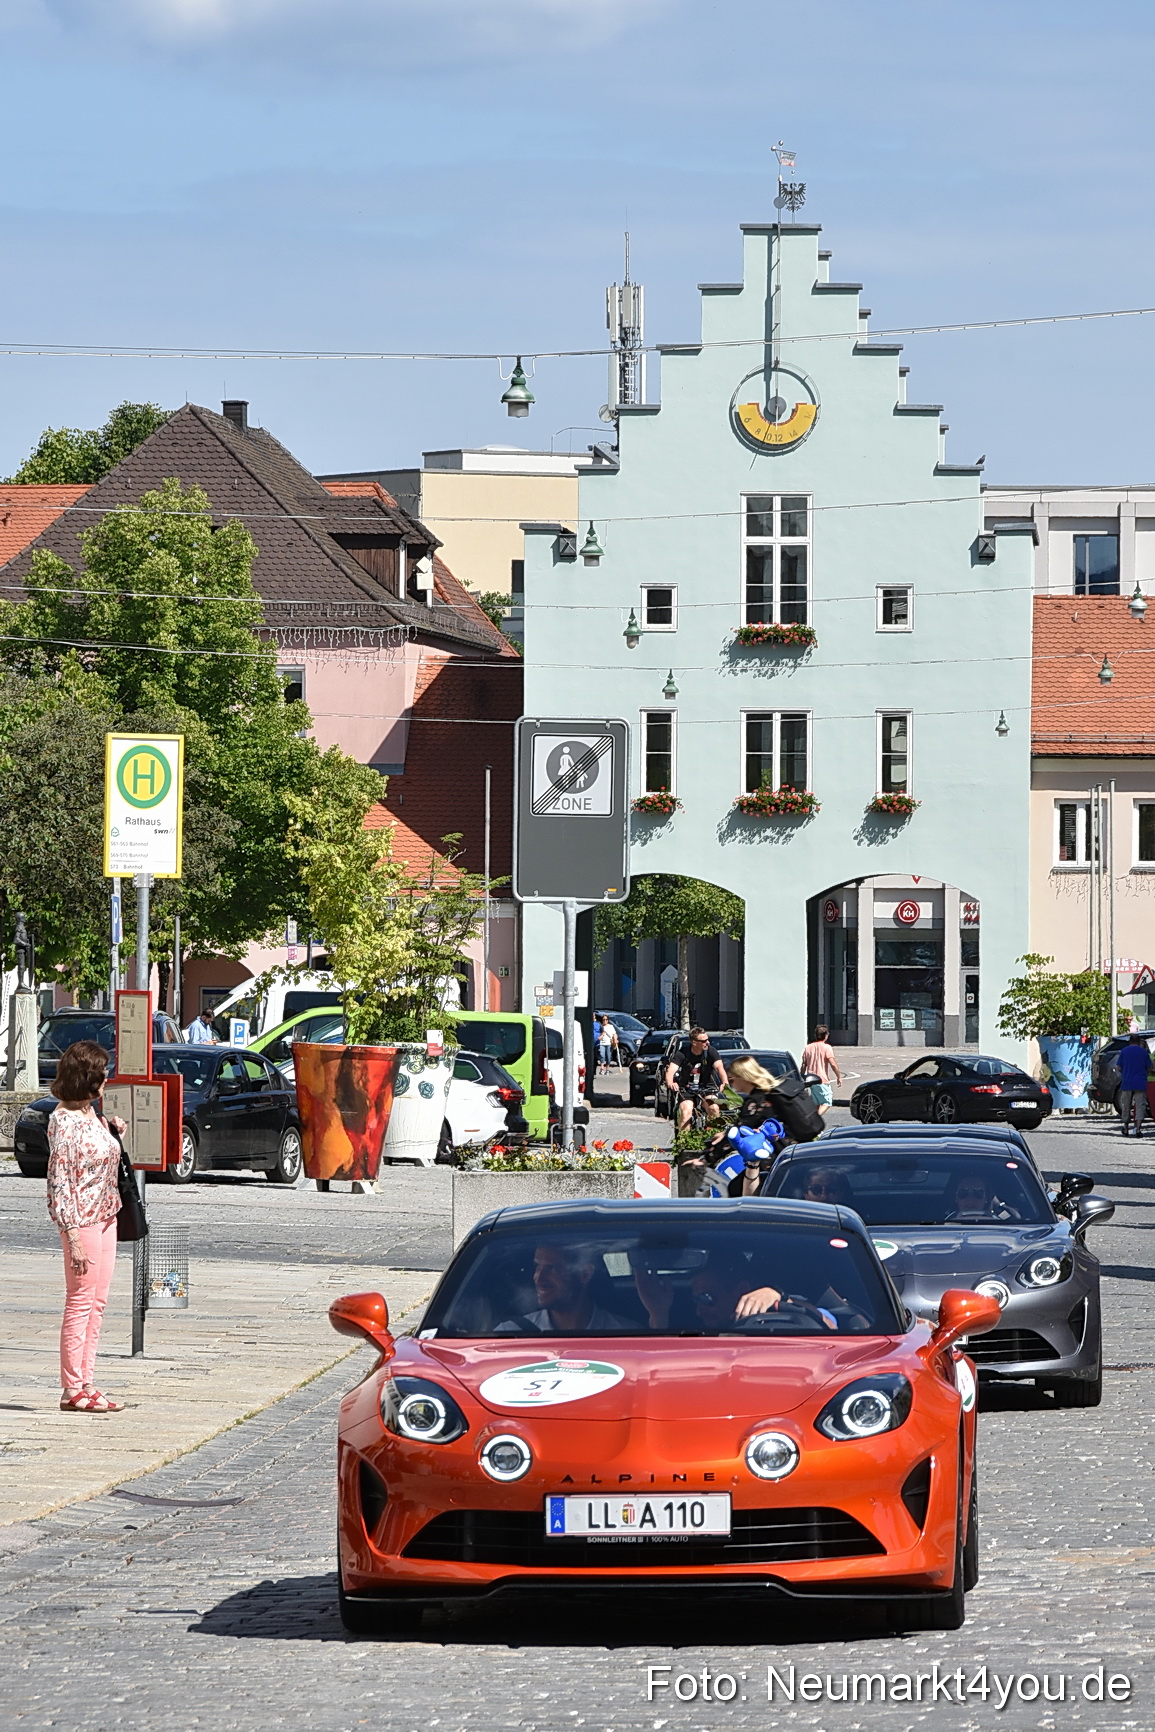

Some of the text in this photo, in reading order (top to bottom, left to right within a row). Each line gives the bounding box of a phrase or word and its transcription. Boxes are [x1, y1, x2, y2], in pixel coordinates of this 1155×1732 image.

[133, 759, 155, 794] H
[552, 798, 592, 810] ZONE
[125, 816, 161, 826] Rathaus
[902, 910, 915, 918] KH
[236, 1025, 243, 1036] P
[561, 1473, 715, 1483] ALPINE
[588, 1502, 617, 1528] LL
[553, 1520, 562, 1529] A
[669, 1535, 689, 1543] AUTO
